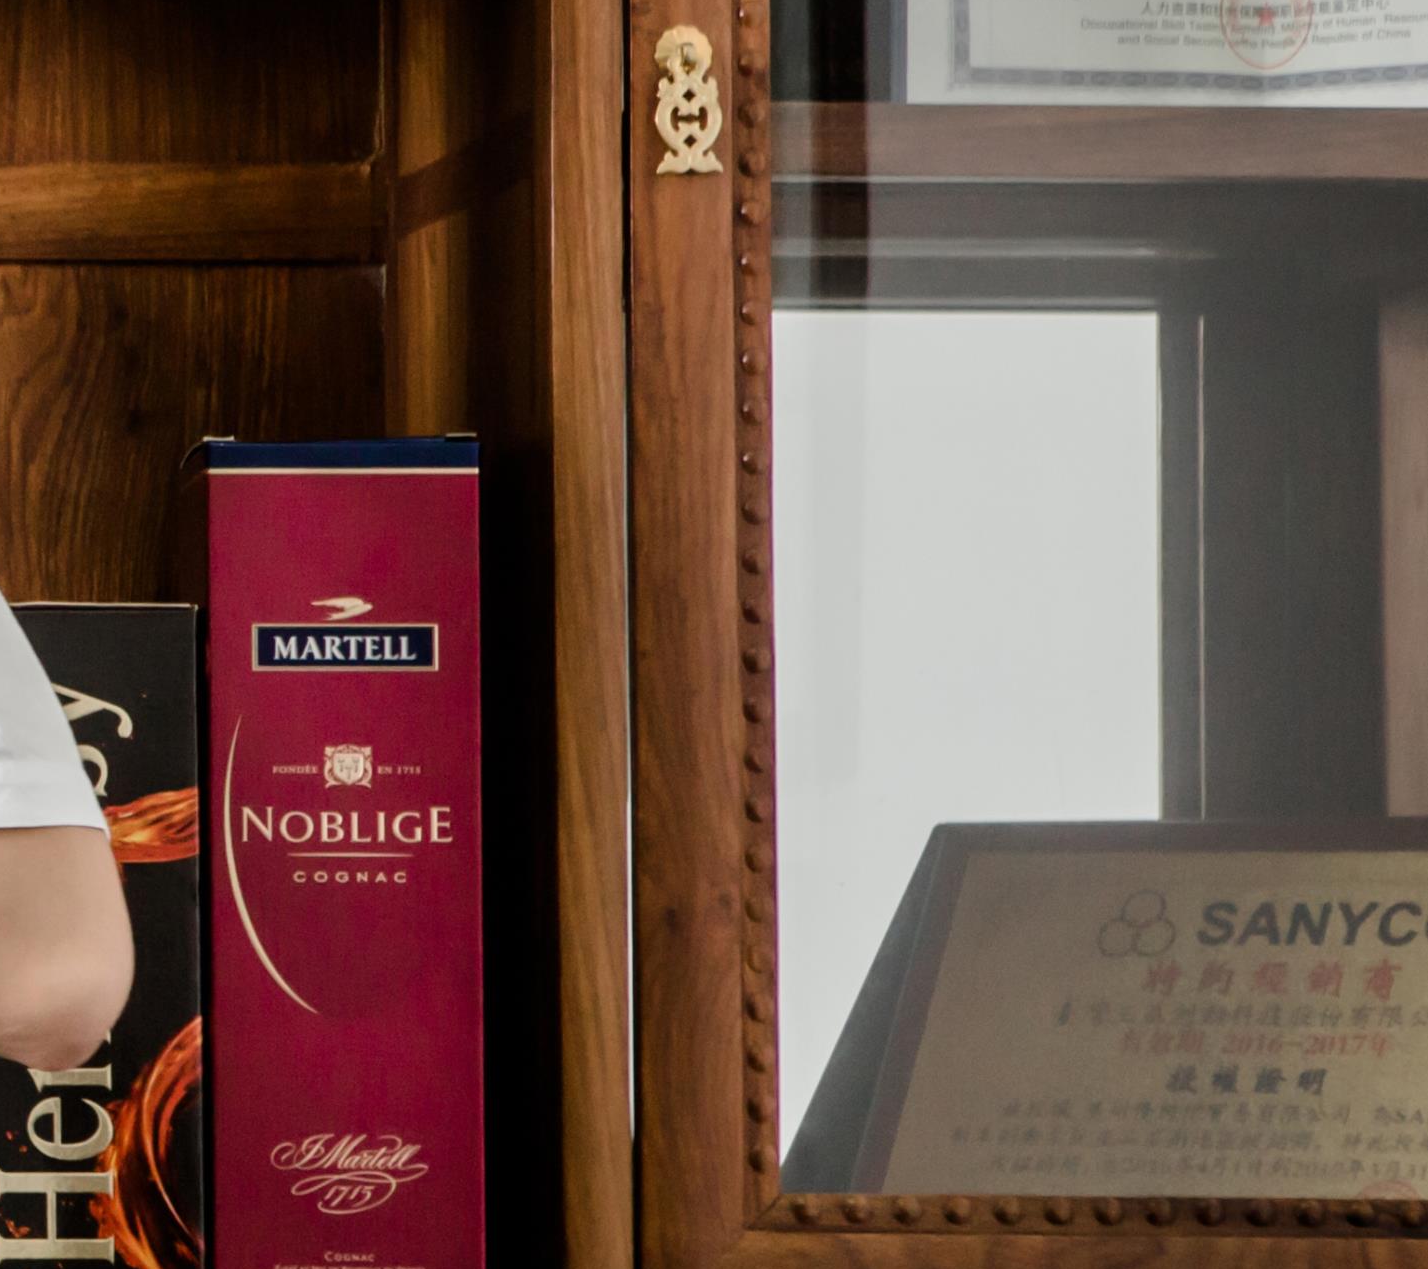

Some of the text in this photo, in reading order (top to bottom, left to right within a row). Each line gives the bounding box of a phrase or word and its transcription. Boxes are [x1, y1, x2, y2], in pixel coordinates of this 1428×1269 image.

[271, 633, 417, 662] MARTELL
[377, 766, 392, 775] EN
[397, 766, 421, 775] 1715
[241, 806, 454, 844] NOBLIGE
[293, 871, 407, 884] COGNAC
[1196, 901, 1428, 947] SANYC
[323, 1185, 375, 1208] 1715
